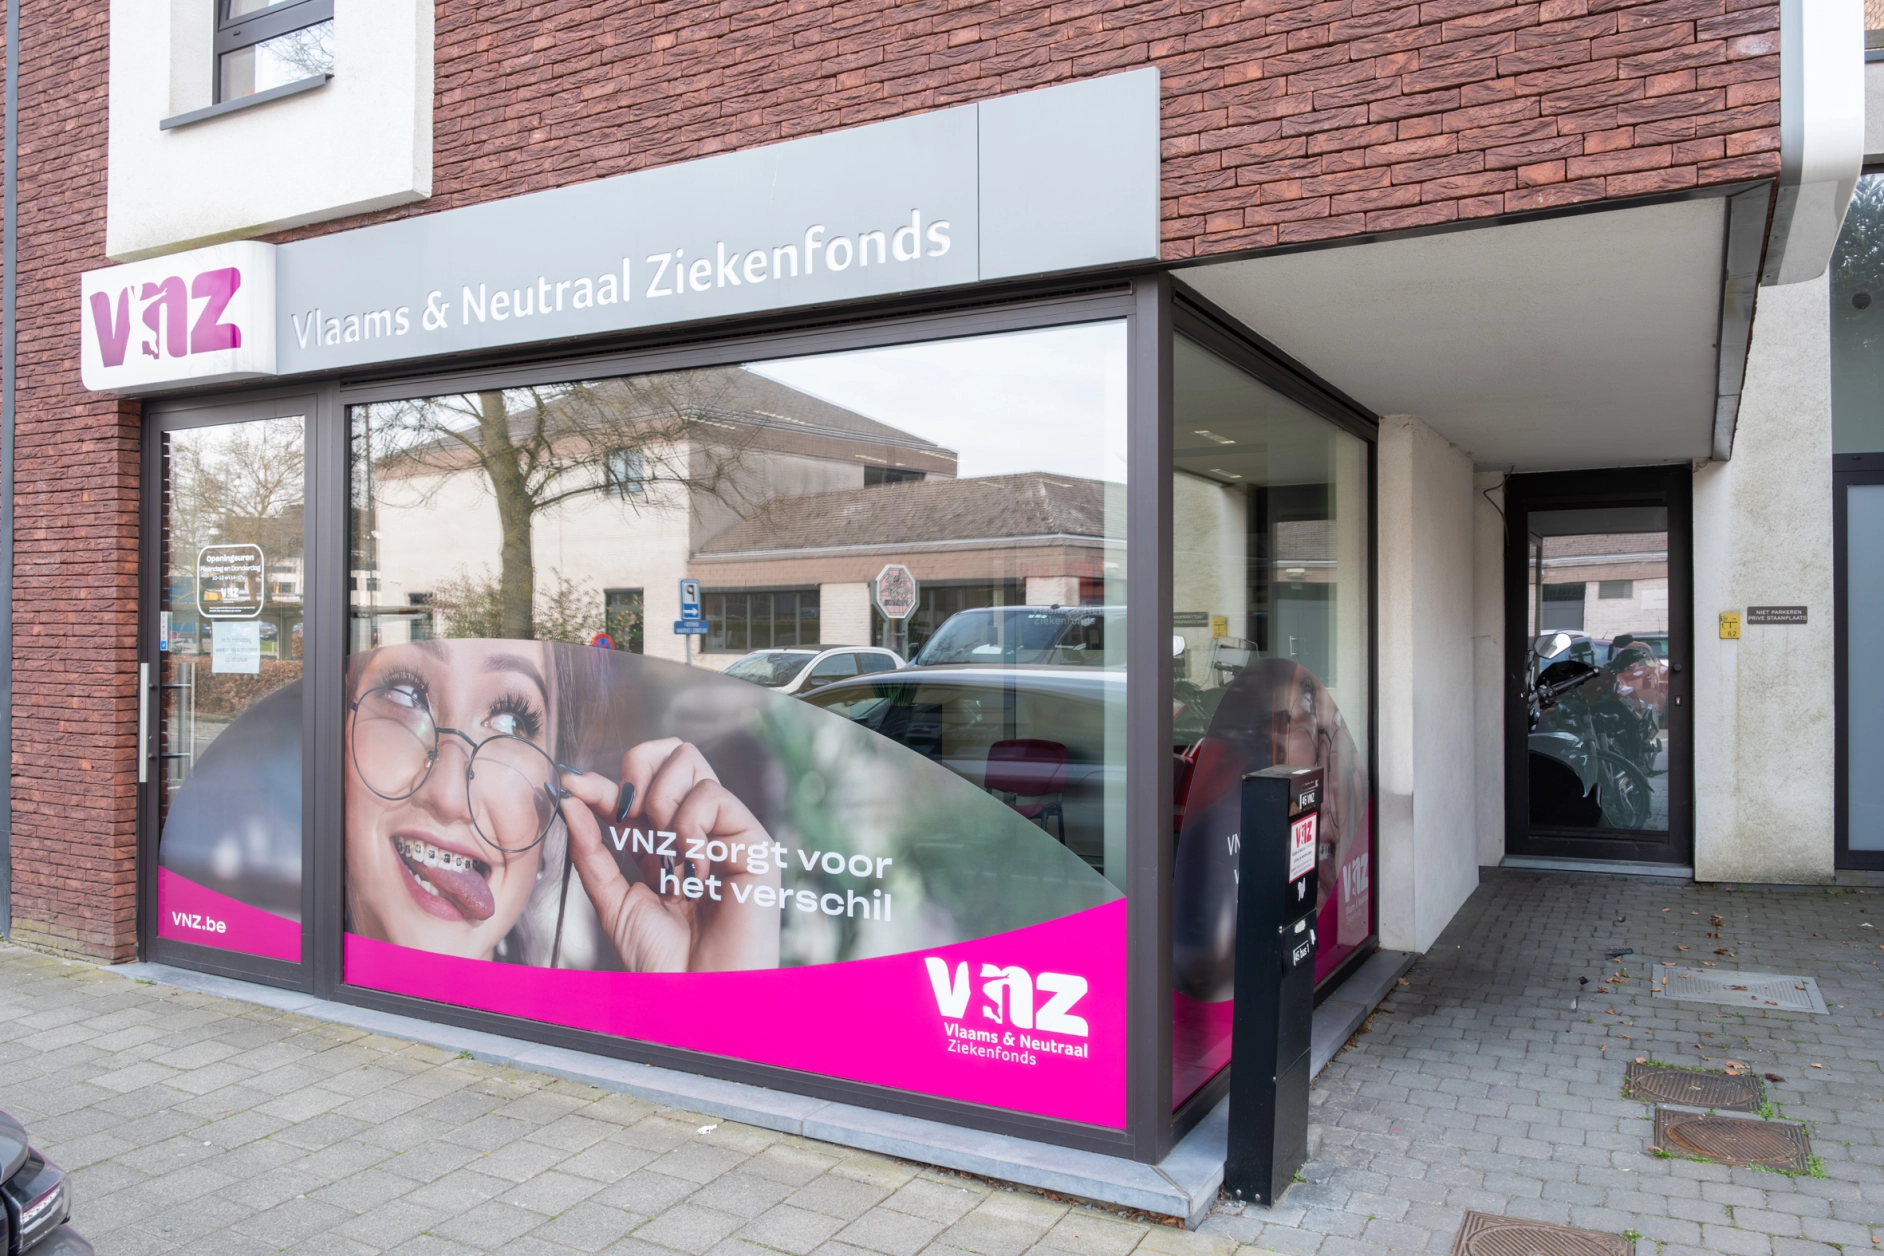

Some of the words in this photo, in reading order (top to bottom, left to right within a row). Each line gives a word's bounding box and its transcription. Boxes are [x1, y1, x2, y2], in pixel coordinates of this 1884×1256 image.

[290, 306, 410, 350] Vlaams
[422, 289, 450, 332] &
[462, 257, 631, 325] Neutraal
[645, 207, 951, 298] Ziekenfonds
[206, 554, 255, 564] Openingsuren
[231, 564, 261, 572] Donderdag
[1034, 615, 1096, 625] Ziekenfonds
[1307, 792, 1315, 804] VNZ
[609, 826, 677, 856] VNZ
[685, 837, 788, 875] zorgt
[797, 849, 893, 879] voor
[660, 868, 722, 901] het
[730, 882, 892, 922] verschil
[171, 911, 227, 934] VNZ.be
[1299, 947, 1307, 959] bus
[944, 1021, 999, 1044] Vlaams
[1002, 1031, 1016, 1047] &
[1019, 1033, 1088, 1058] Neutraal
[947, 1038, 1037, 1066] Ziekenfonds
